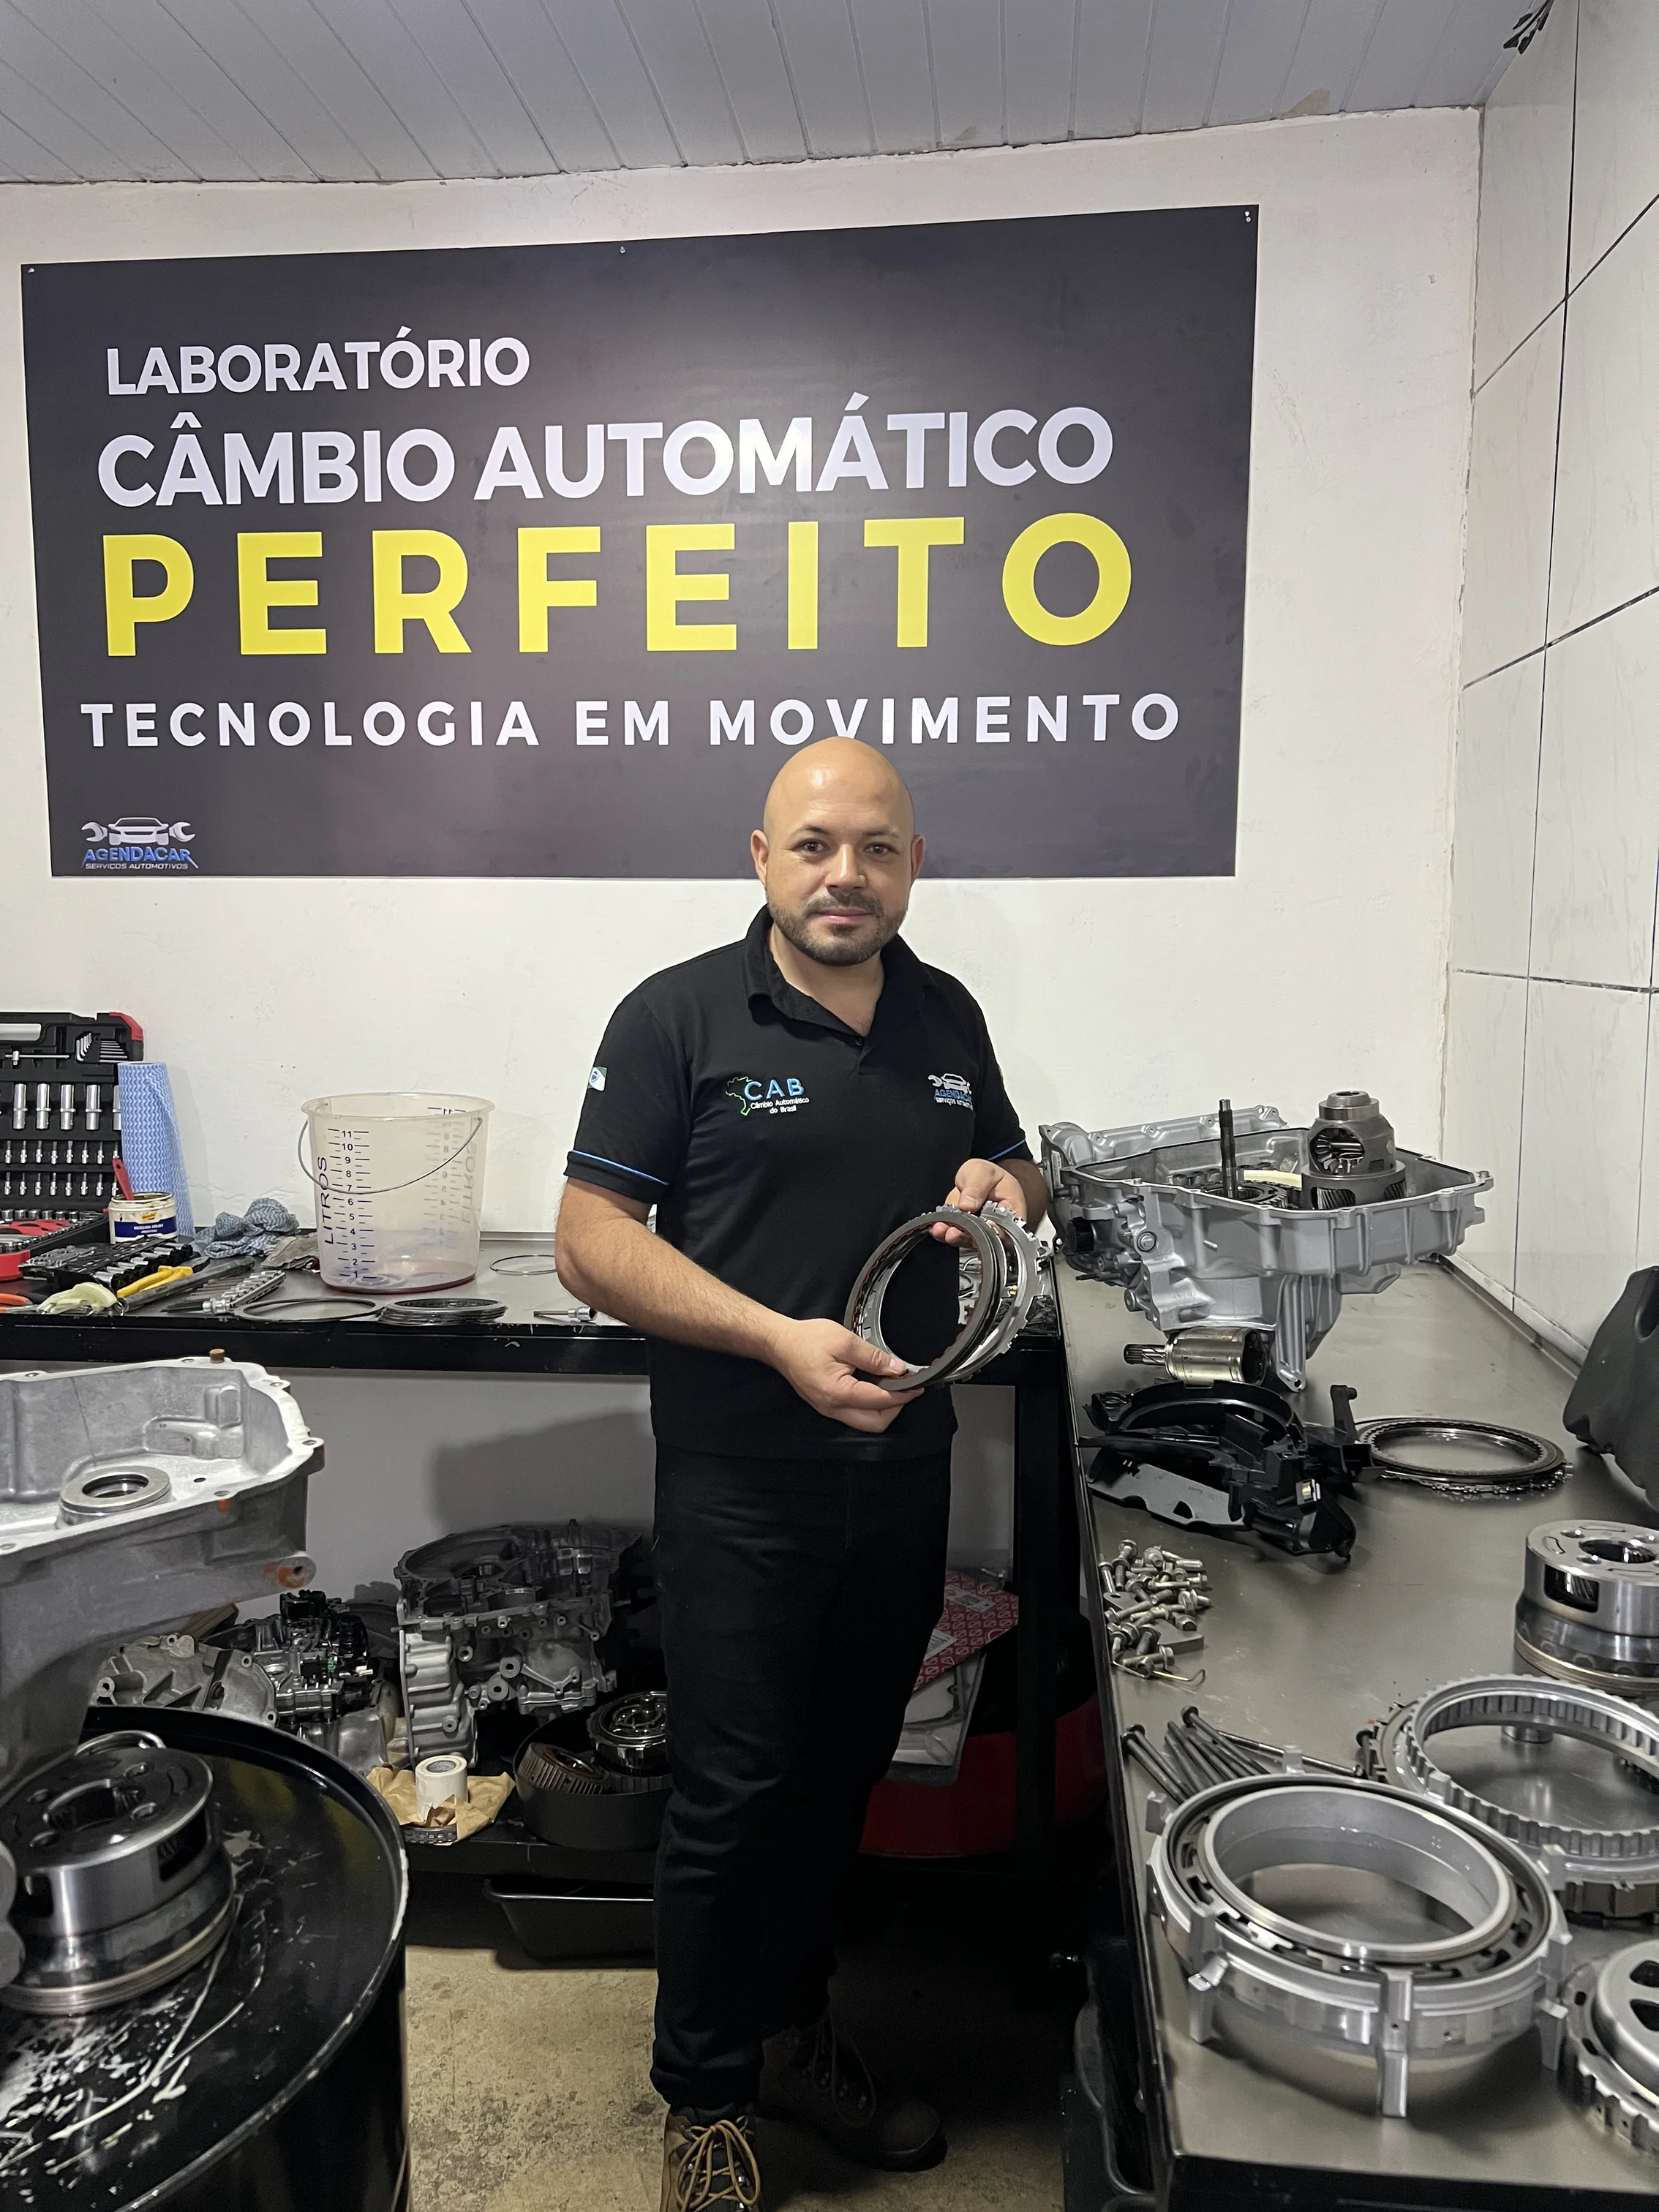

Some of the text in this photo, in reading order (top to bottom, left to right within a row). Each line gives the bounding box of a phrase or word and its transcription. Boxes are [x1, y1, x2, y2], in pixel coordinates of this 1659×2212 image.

[107, 326, 530, 395] LABORATÓRIO
[98, 391, 1113, 507] CÂMBIO AUTOMÁTICO
[103, 513, 1132, 656] PERFEITO
[80, 693, 1179, 747] TECNOLOGIA EM MOVIMENTO
[81, 846, 199, 869] AGENDACAR
[744, 1078, 805, 1101] CAB
[775, 1097, 810, 1106] Automático
[341, 1130, 352, 1138] 11
[317, 1156, 334, 1244] LITROS
